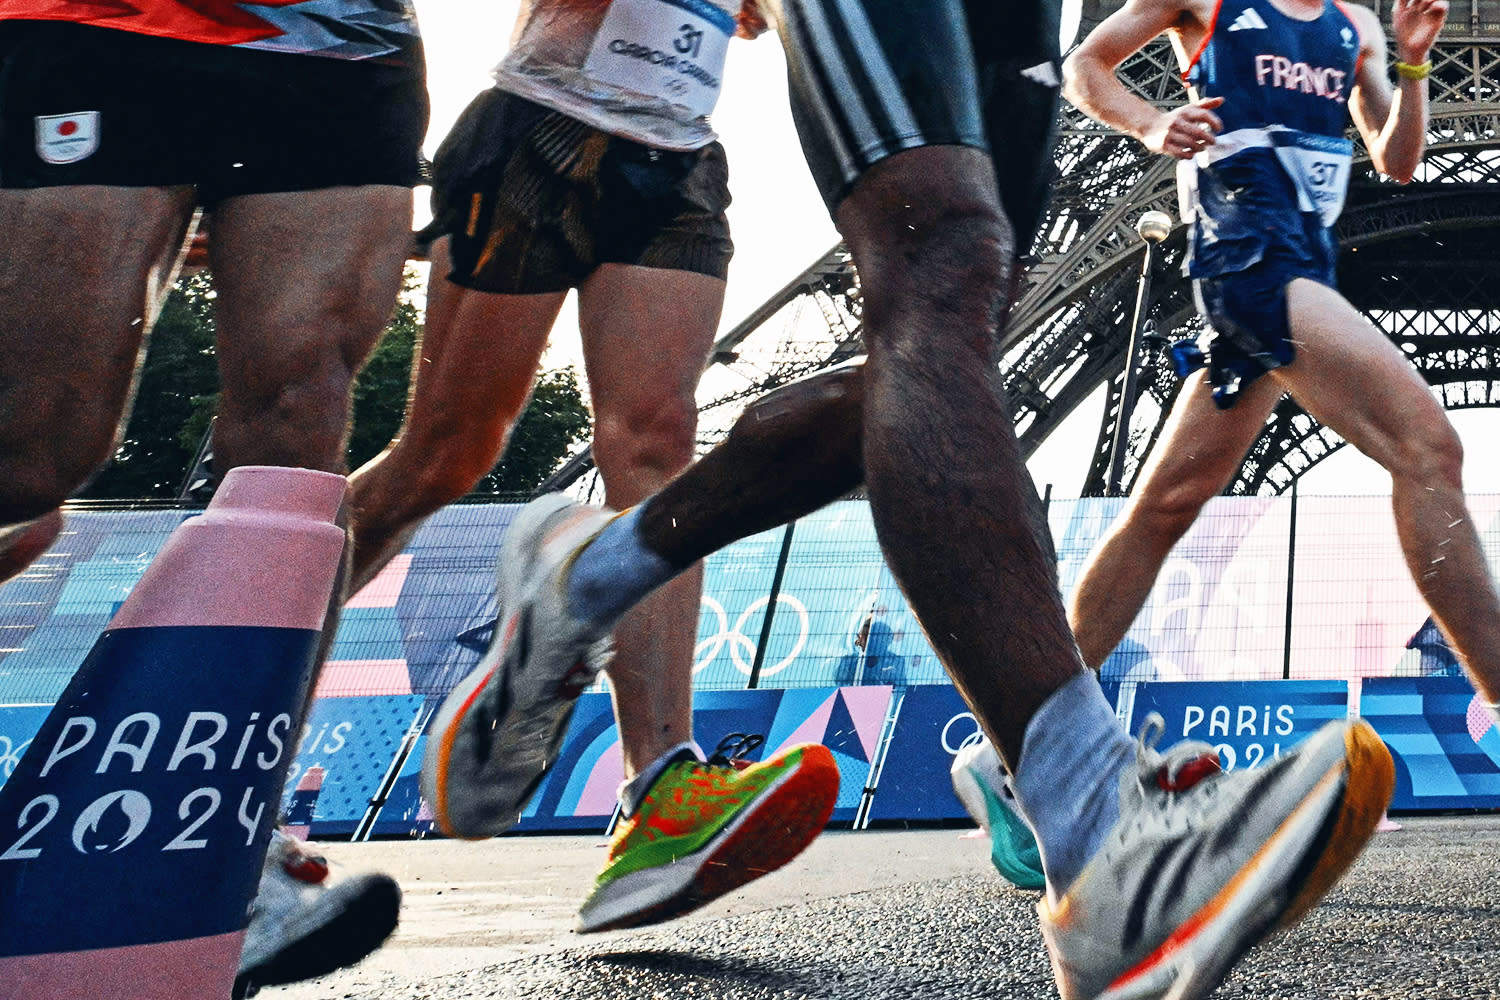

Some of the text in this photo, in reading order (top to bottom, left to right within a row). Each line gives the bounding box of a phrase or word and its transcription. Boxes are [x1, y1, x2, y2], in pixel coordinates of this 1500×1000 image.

[673, 23, 704, 58] 31
[1308, 161, 1339, 187] 37
[0, 786, 265, 860] 2024
